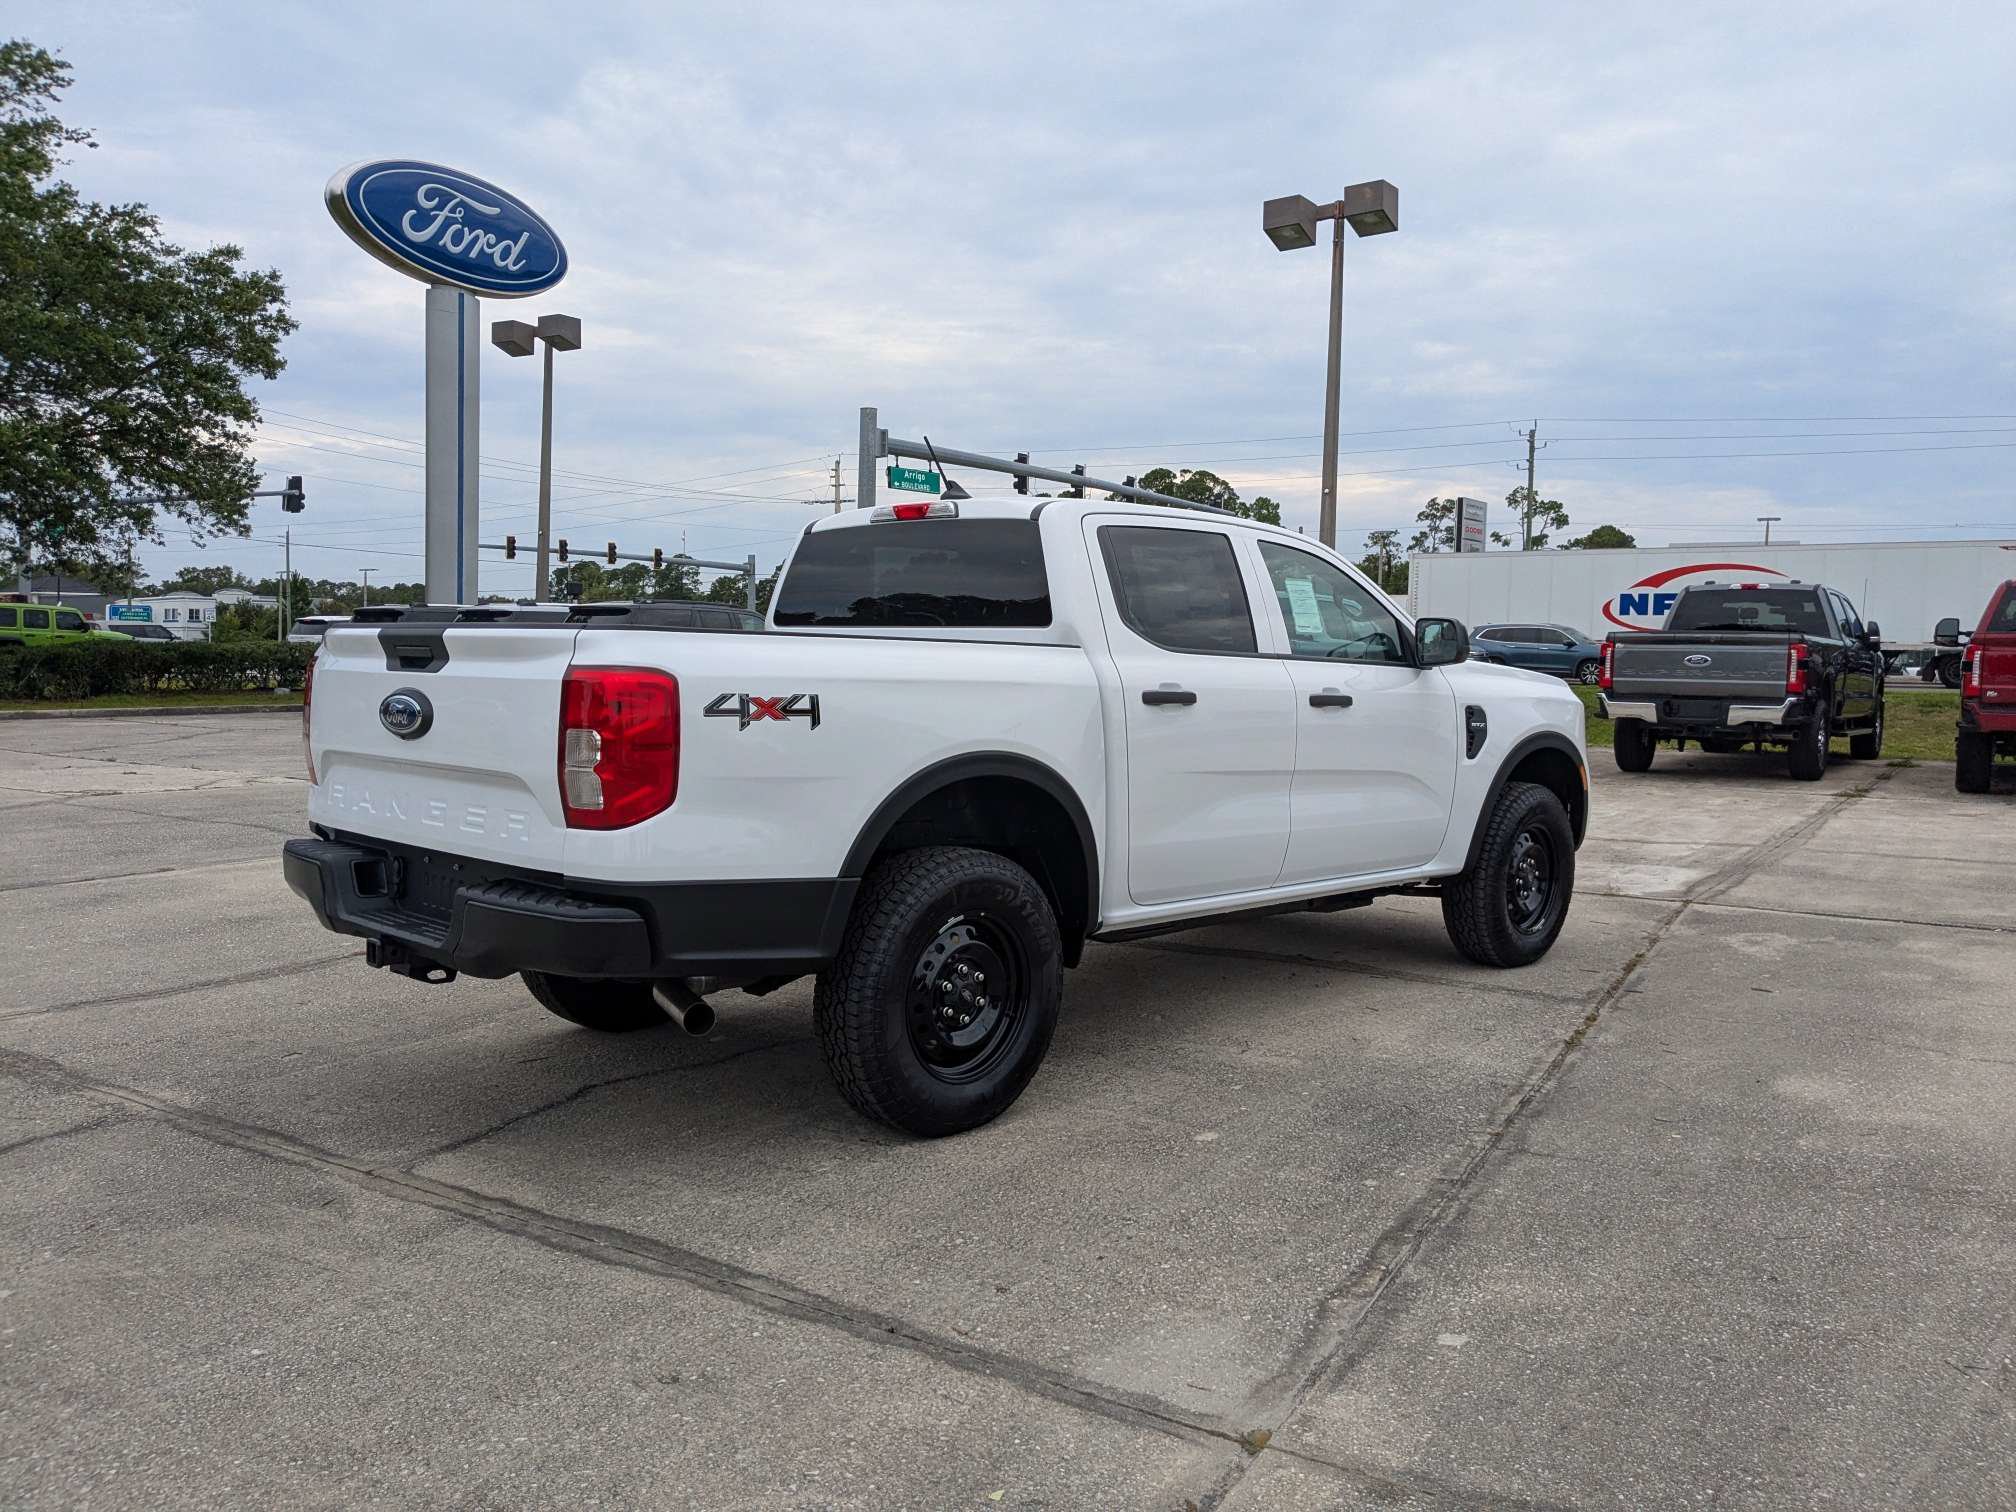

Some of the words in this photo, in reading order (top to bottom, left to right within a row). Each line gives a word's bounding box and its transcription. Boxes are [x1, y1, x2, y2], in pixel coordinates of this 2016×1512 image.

[402, 184, 529, 271] Ford
[904, 470, 925, 482] Arrigo
[1619, 593, 1678, 616] NF
[386, 702, 409, 725] Ford
[328, 784, 529, 842] RANGER
